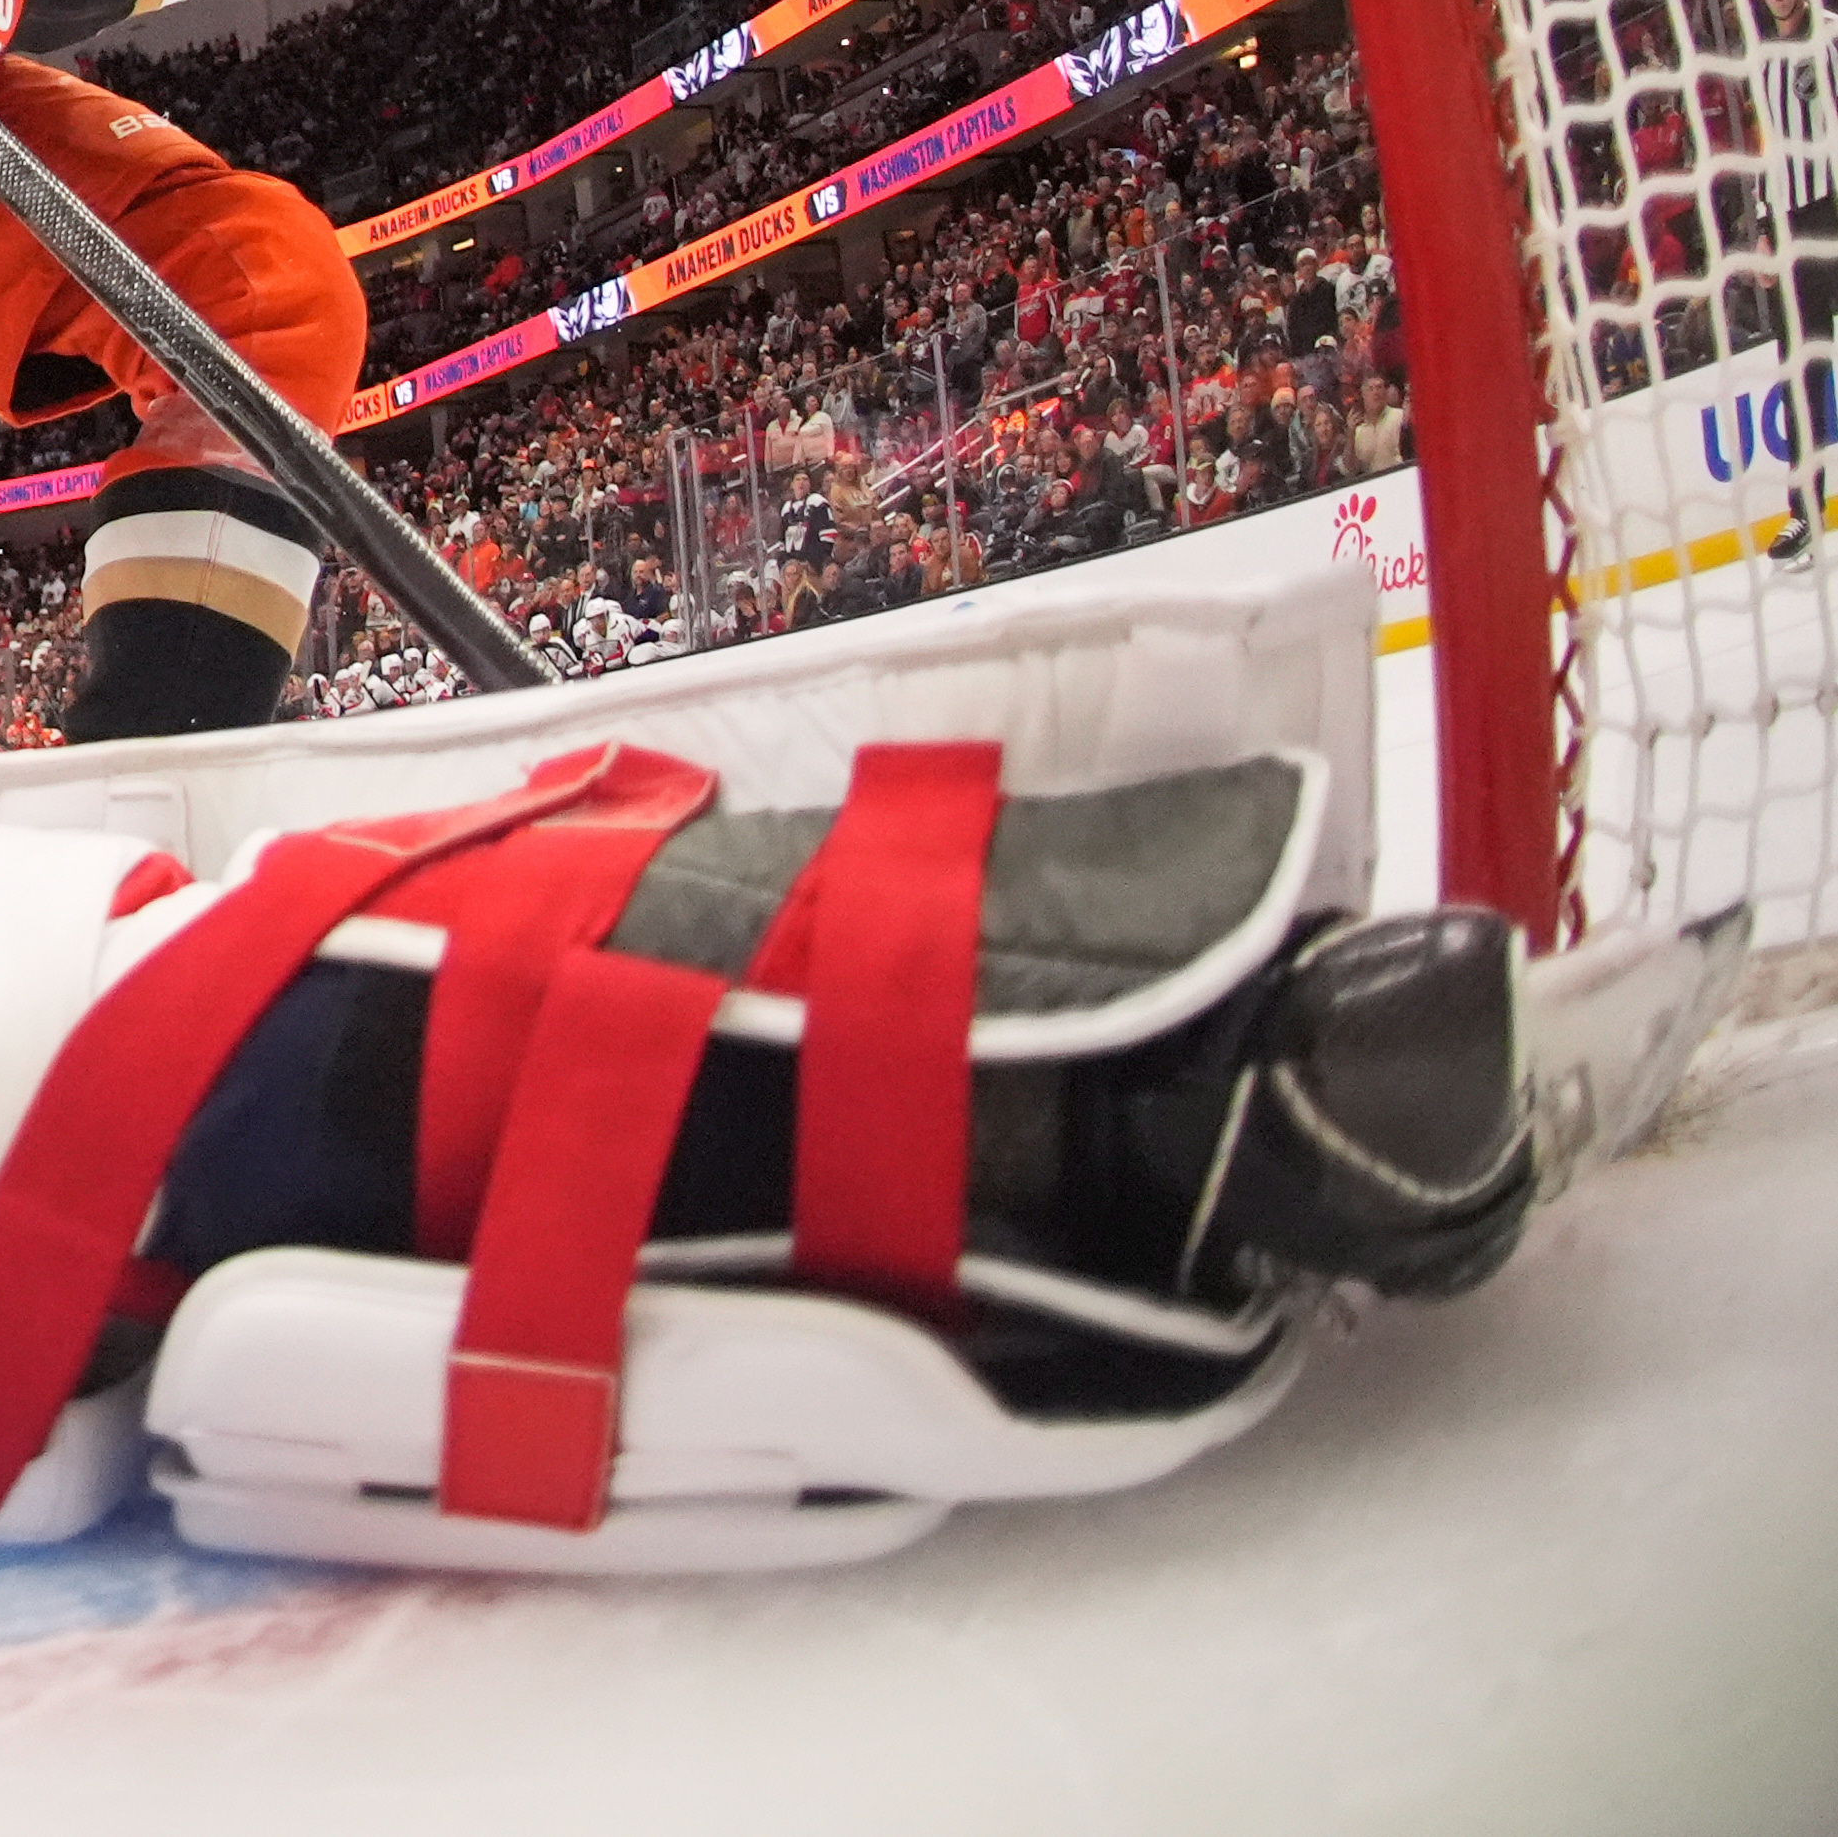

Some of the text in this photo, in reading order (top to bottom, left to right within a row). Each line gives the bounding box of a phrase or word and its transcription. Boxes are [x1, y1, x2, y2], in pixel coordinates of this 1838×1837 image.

[369, 200, 430, 245] ANAHEIM
[431, 182, 480, 218] DUCKS
[490, 166, 515, 194] VS
[665, 232, 736, 291] ANAHEIM
[738, 205, 797, 257] DUCKS
[811, 184, 841, 220] VS
[392, 379, 414, 408] VS
